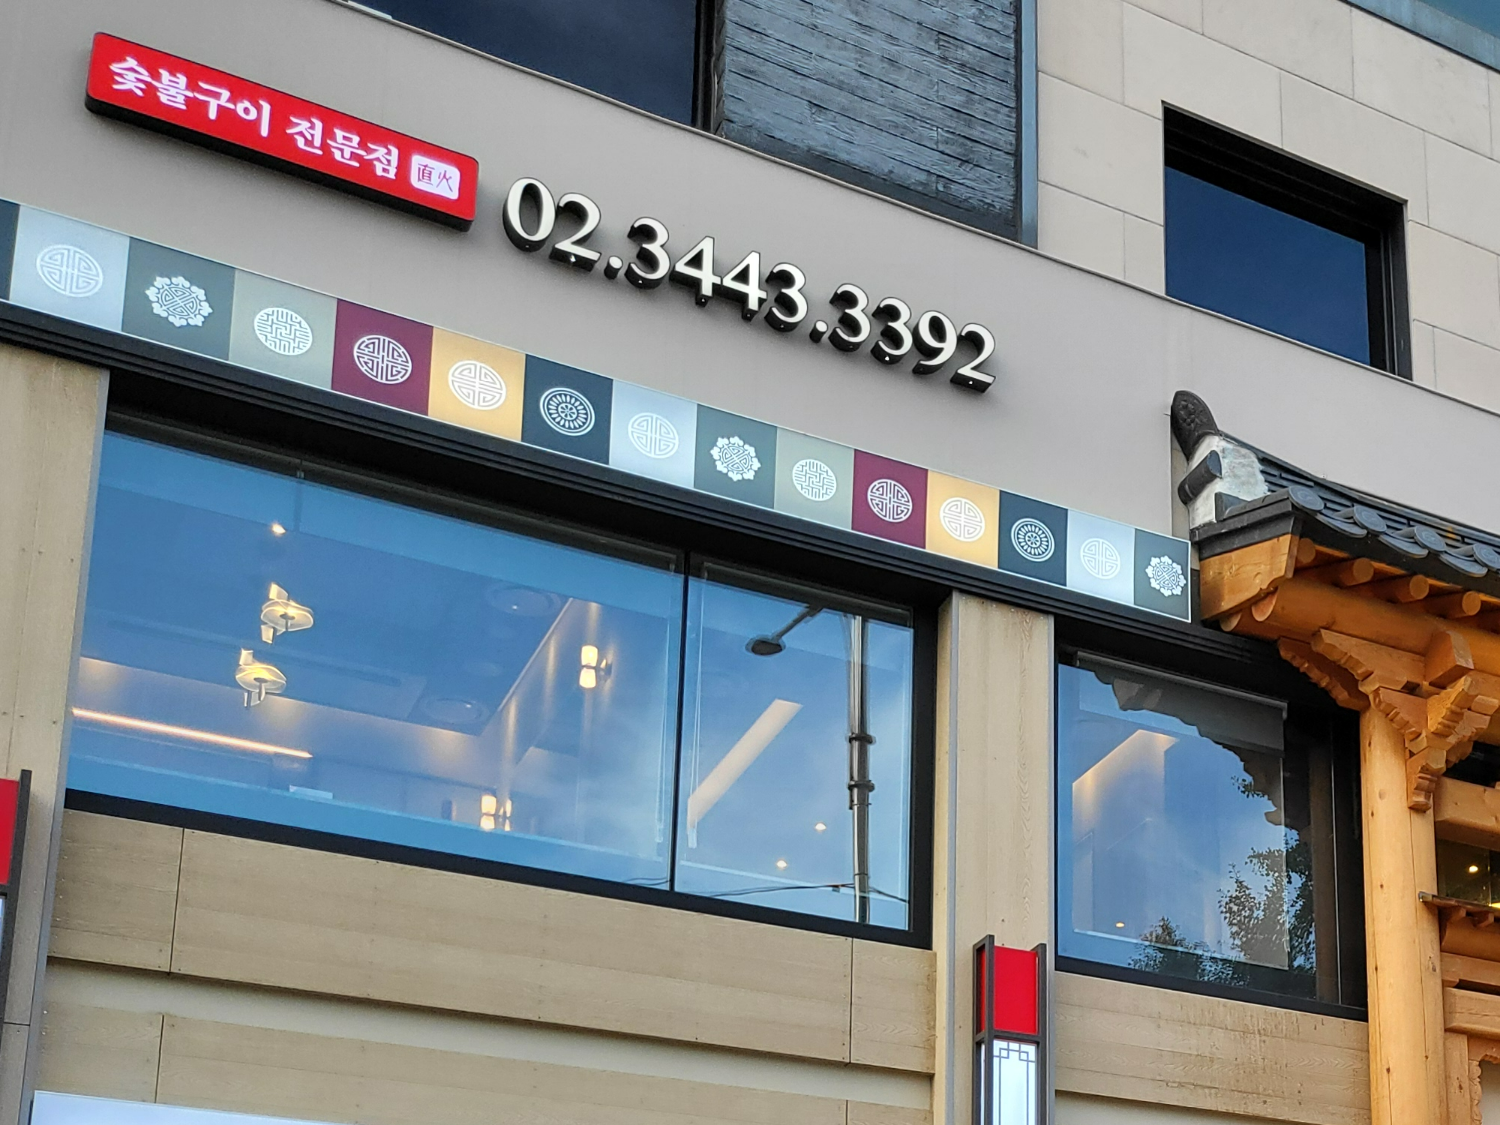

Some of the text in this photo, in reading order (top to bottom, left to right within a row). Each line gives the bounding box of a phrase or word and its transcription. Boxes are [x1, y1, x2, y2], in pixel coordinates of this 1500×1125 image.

[110, 57, 454, 193] 숯불구이 전문점 直火
[503, 177, 996, 391] 02.3443.3392
